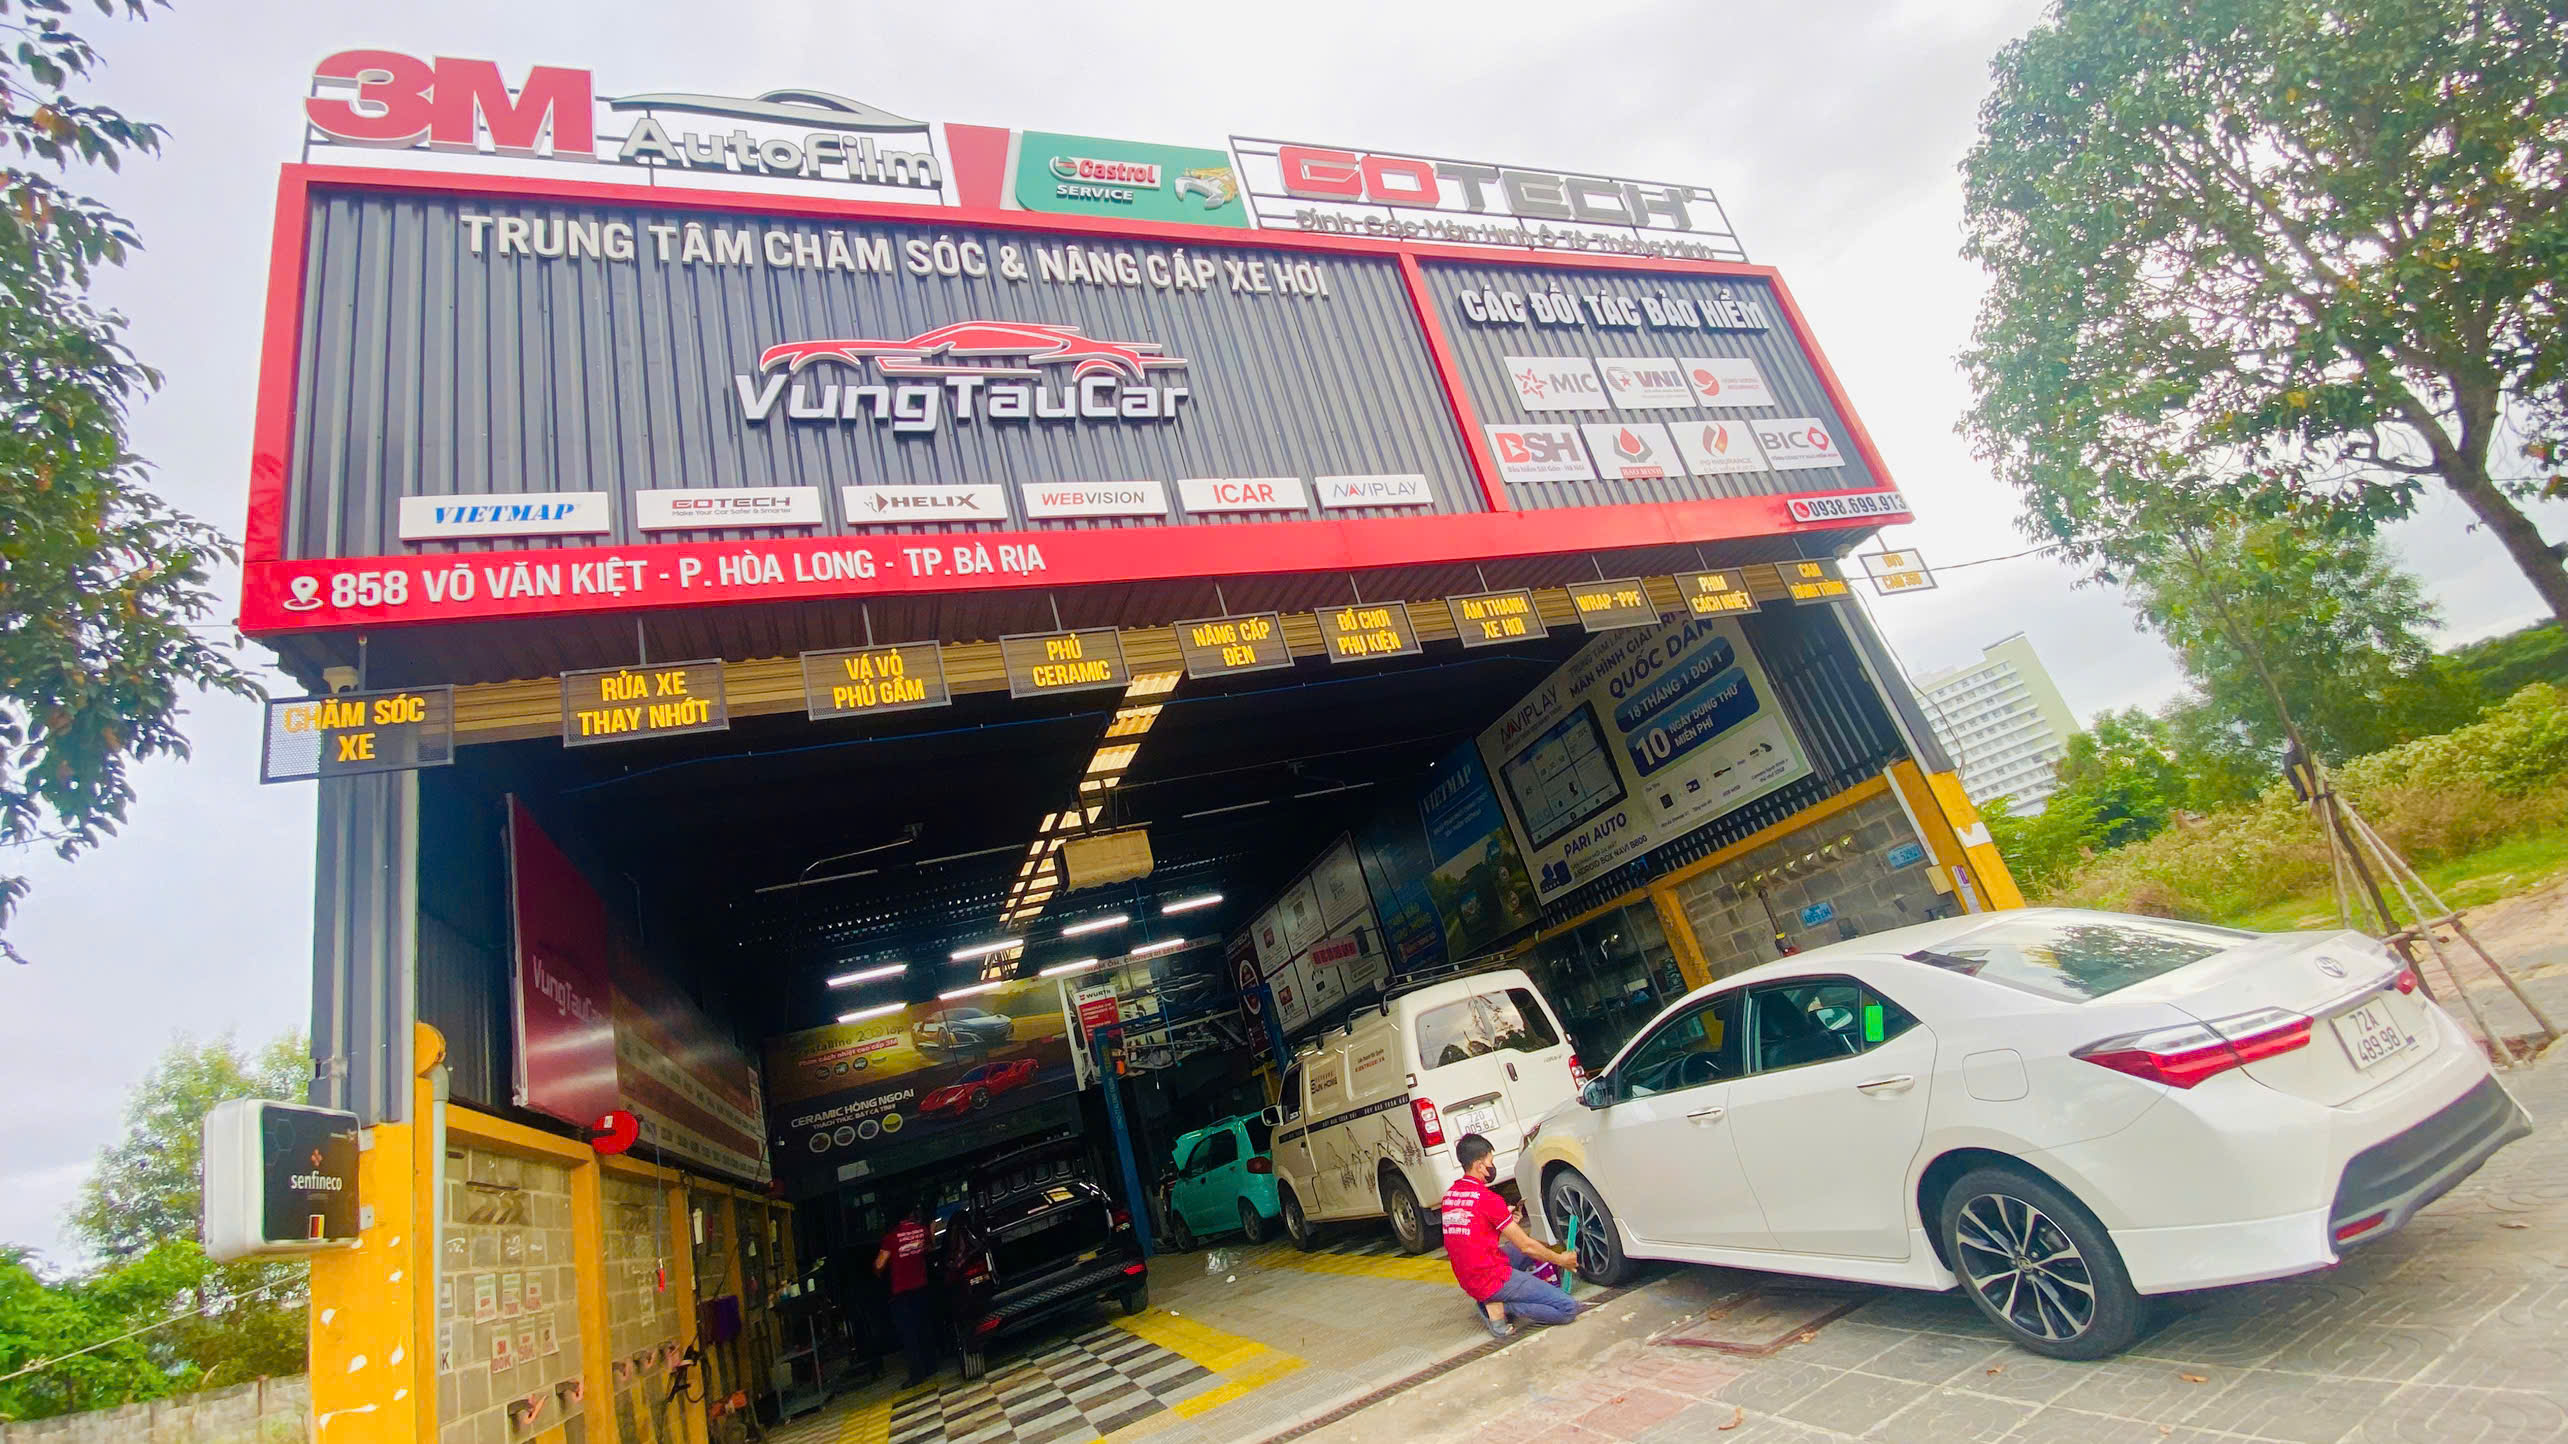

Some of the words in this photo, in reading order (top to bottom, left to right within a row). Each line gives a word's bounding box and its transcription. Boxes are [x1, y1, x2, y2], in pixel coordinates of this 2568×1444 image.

[304, 49, 597, 161] 3M
[618, 117, 944, 189] AutoFilm
[1079, 159, 1156, 184] Castrol
[1056, 184, 1134, 202] SERVICE
[1277, 146, 1693, 231] GOTECH
[1363, 215, 1420, 237] Cao
[1665, 239, 1715, 259] Minh
[460, 215, 634, 263] TRUNG
[649, 222, 754, 267] TÂM
[764, 230, 893, 275] CHĂM
[906, 235, 986, 279] SÓC
[1001, 246, 1028, 282] &
[1037, 245, 1141, 288] NÂNG
[1146, 248, 1216, 291] CẤP
[1224, 260, 1271, 294] XE
[1272, 261, 1330, 298] HƠI
[1462, 285, 1527, 325] CÁC
[1529, 282, 1586, 326] ĐỐI
[1584, 289, 1641, 327] TÁC
[1641, 289, 1700, 329] BẢO
[1698, 289, 1770, 330] HIỂM
[1549, 373, 1599, 393] MIC
[1633, 371, 1683, 387] VNI
[735, 374, 1189, 433] VungTauCar
[1495, 432, 1581, 463] BSH
[1640, 466, 1663, 476] MINH
[672, 497, 791, 509] GOTECH
[890, 493, 980, 510] HELIX
[1041, 491, 1145, 506] WEBVISION
[1212, 484, 1275, 503] ICAR
[1333, 481, 1418, 498] NAVIPLAY
[435, 504, 575, 523] VIETMAP
[1808, 494, 1907, 517] 0938.699.913
[331, 571, 408, 608] 858
[423, 563, 475, 603] VÕ
[484, 561, 560, 599] VĂN
[572, 557, 648, 598] KIỆT
[679, 558, 712, 588] P.
[719, 549, 784, 587] HÒA
[793, 549, 876, 582] LONG
[903, 547, 951, 577] TP.
[954, 542, 994, 575] BÀ
[998, 544, 1047, 577] RỊA
[1698, 575, 1728, 592] PHIM
[1461, 600, 1485, 620] ÂM
[1483, 597, 1529, 617] THANH
[1691, 594, 1722, 613] CÁCH
[1192, 624, 1236, 648] NÂNG
[1239, 617, 1270, 641] CẤP
[1336, 608, 1360, 632] ĐỒ
[1360, 608, 1392, 628] CHƠI
[1481, 619, 1502, 639] XE
[1502, 616, 1526, 637] HƠI
[1046, 632, 1083, 662] PHỦ
[1222, 644, 1256, 667] ĐÈN
[1337, 636, 1368, 656] PHỤ
[1367, 630, 1401, 655] KIỆN
[845, 654, 874, 681] VÁ
[875, 648, 903, 677] VỎ
[1032, 660, 1111, 688] CERAMIC
[1609, 647, 1664, 699] QUỐC
[601, 670, 648, 702] RỬA
[656, 671, 688, 697] XE
[833, 678, 876, 710] PHỦ
[880, 675, 926, 705] GẦM
[1627, 705, 1642, 721] 18
[1641, 679, 1682, 711] THÁNG
[1681, 673, 1690, 685] 1
[1713, 650, 1724, 663] 1
[284, 698, 366, 733] CHĂM
[374, 693, 426, 725] SÓC
[577, 707, 642, 736] THAY
[649, 697, 711, 729] NHỚT
[1500, 684, 1557, 745] NAVIPLAY
[337, 732, 376, 762] XE
[1635, 727, 1671, 767] 10
[1564, 831, 1592, 859] PARI
[1593, 812, 1627, 842] AUTO
[2349, 1008, 2380, 1035] 72A
[2357, 1027, 2401, 1062] 489.98
[791, 1107, 844, 1127] CERAMIC
[290, 1170, 343, 1191] senfineco
